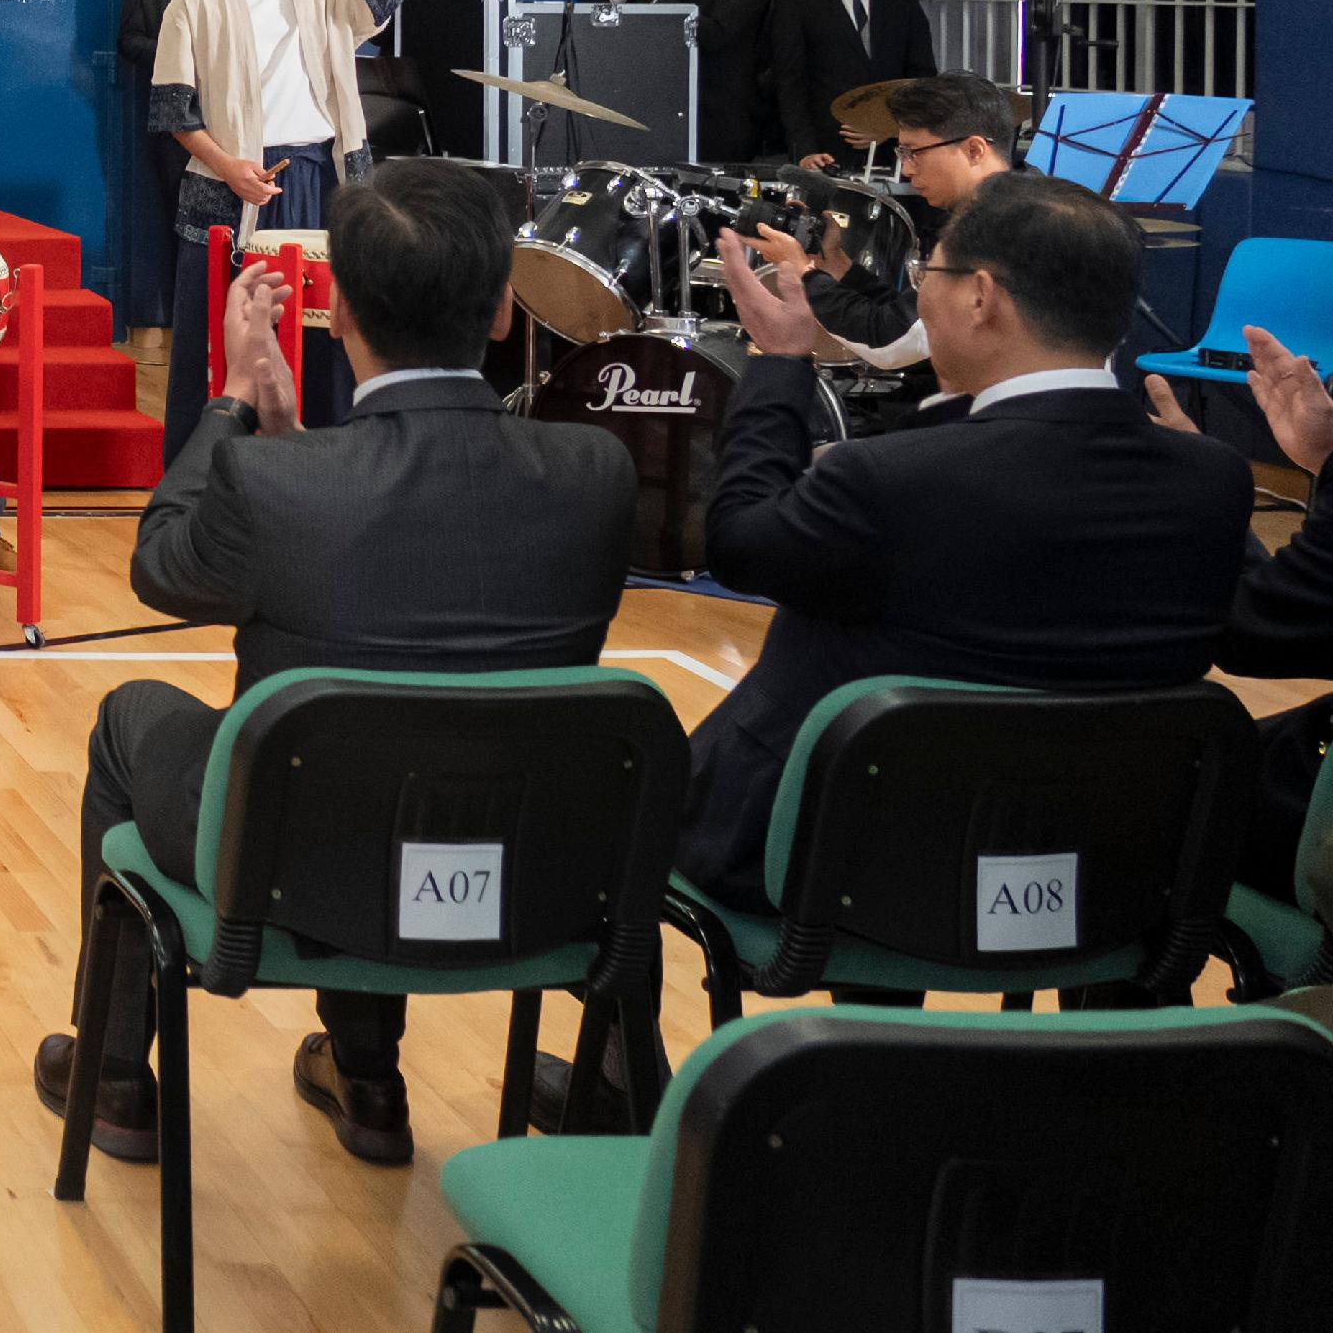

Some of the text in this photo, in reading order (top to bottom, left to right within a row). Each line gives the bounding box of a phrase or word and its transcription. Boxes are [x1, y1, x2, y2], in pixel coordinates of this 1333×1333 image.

[586, 362, 697, 411] Pearl
[412, 869, 491, 904] A07
[987, 878, 1064, 915] A08
